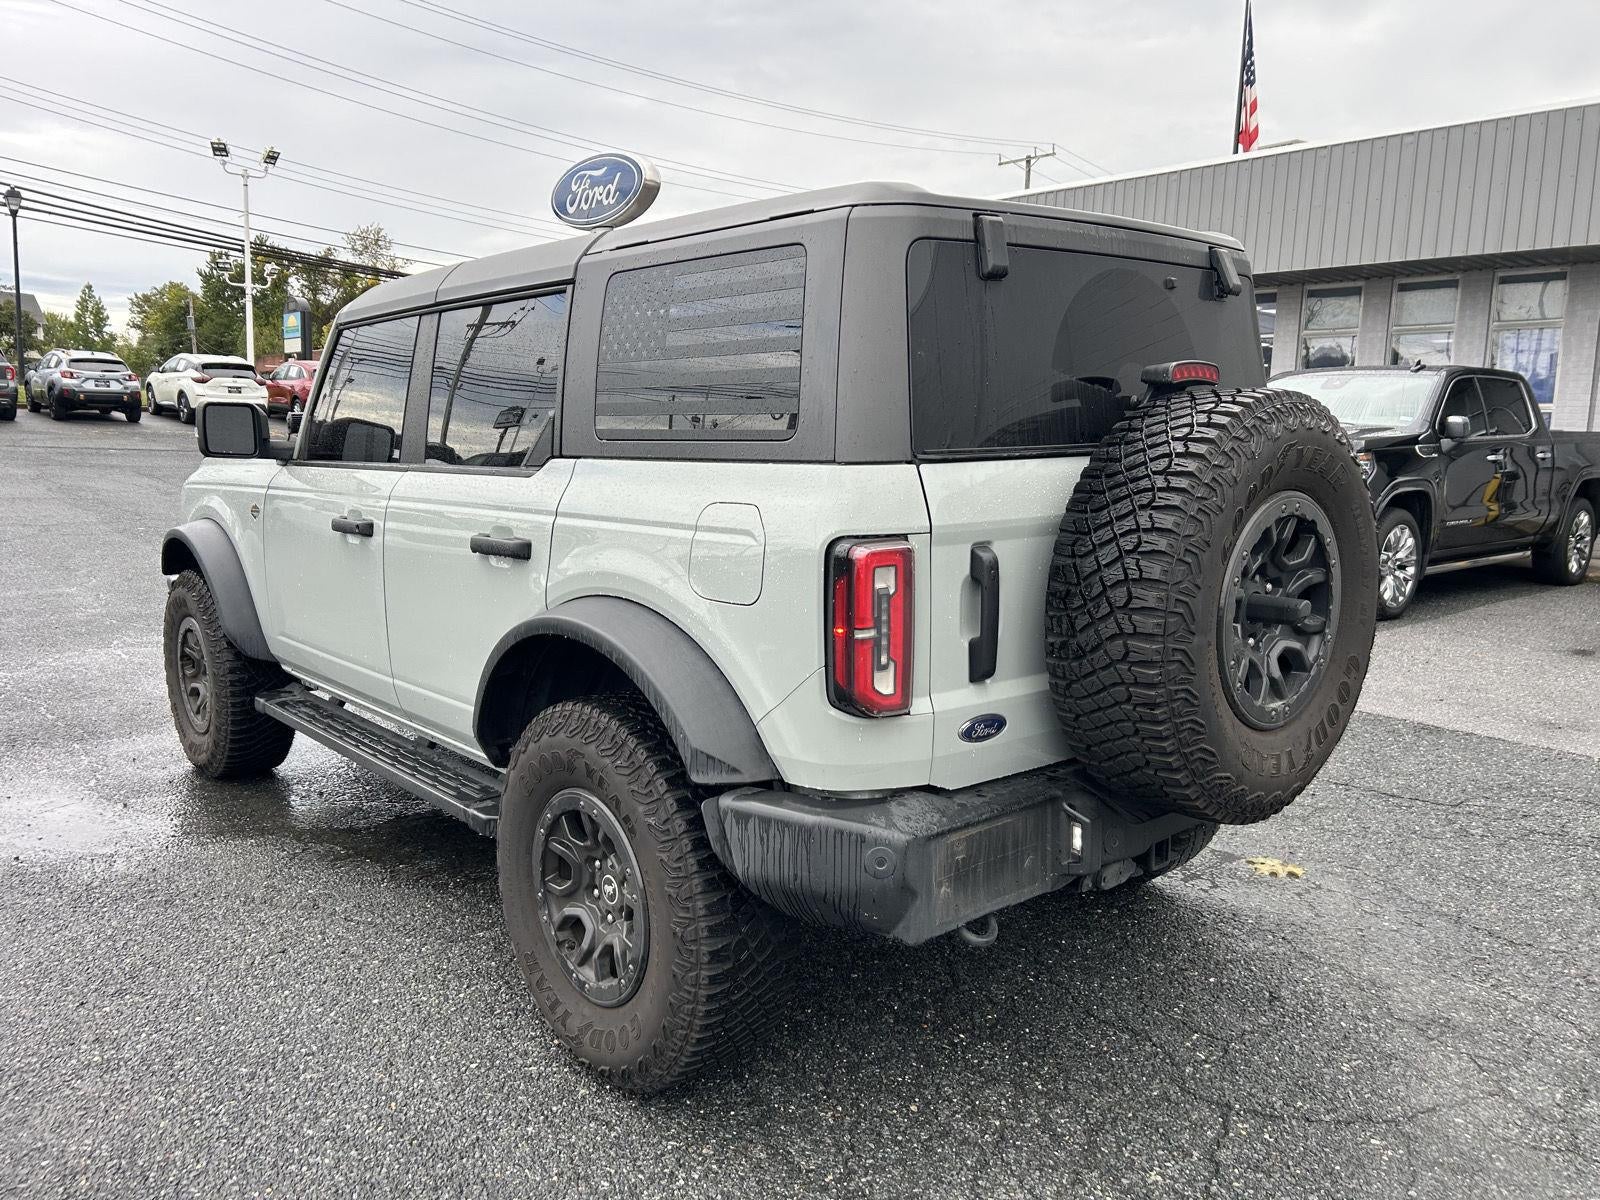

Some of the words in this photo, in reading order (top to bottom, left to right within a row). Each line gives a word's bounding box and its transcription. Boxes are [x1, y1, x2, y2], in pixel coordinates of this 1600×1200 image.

[566, 166, 622, 214] Ford
[971, 722, 998, 738] Ford
[1238, 654, 1361, 778] GOODYEAR
[518, 748, 638, 841] GOODYEAR
[522, 950, 643, 1056] GOODYEAR
